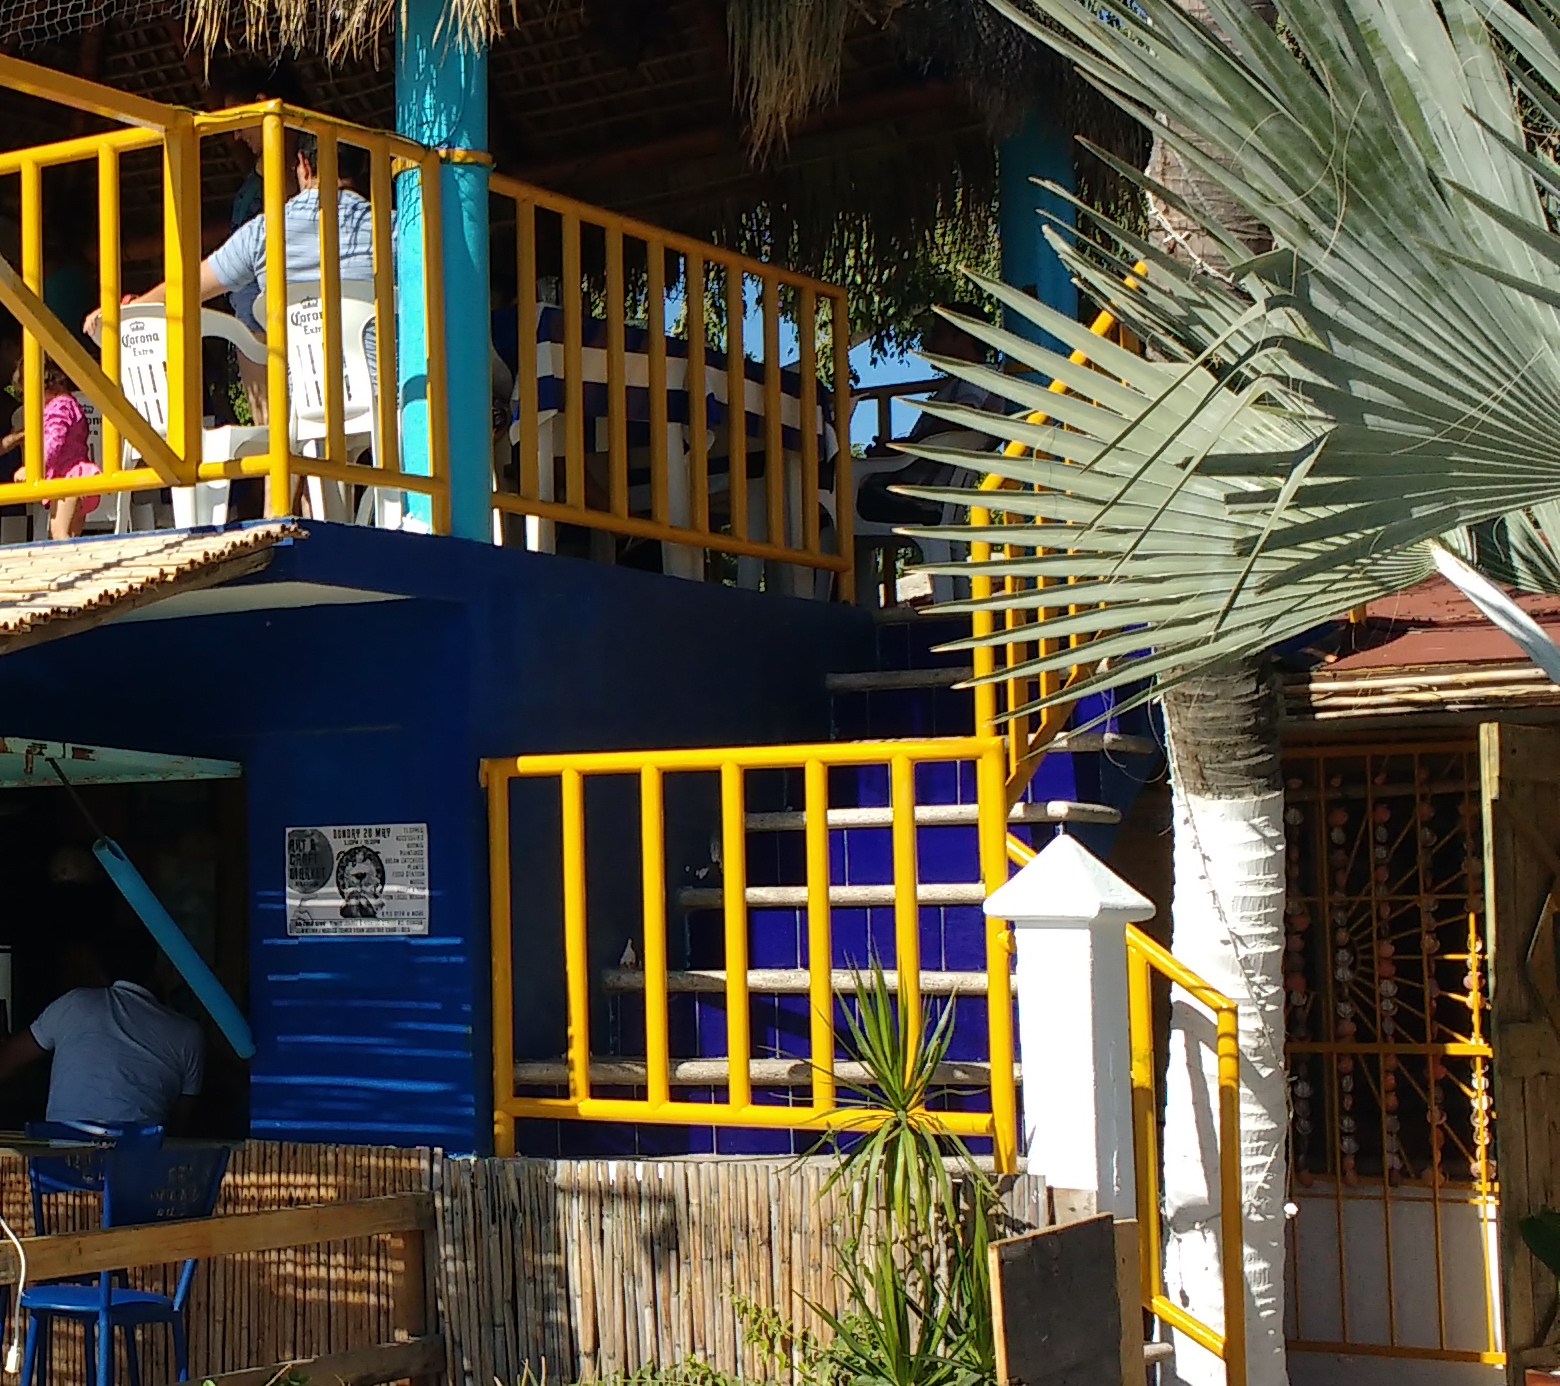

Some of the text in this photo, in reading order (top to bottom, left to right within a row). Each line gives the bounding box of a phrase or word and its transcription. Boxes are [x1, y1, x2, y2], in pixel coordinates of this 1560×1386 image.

[291, 311, 323, 327] Coro
[303, 325, 322, 335] Extr
[121, 333, 160, 348] Corona
